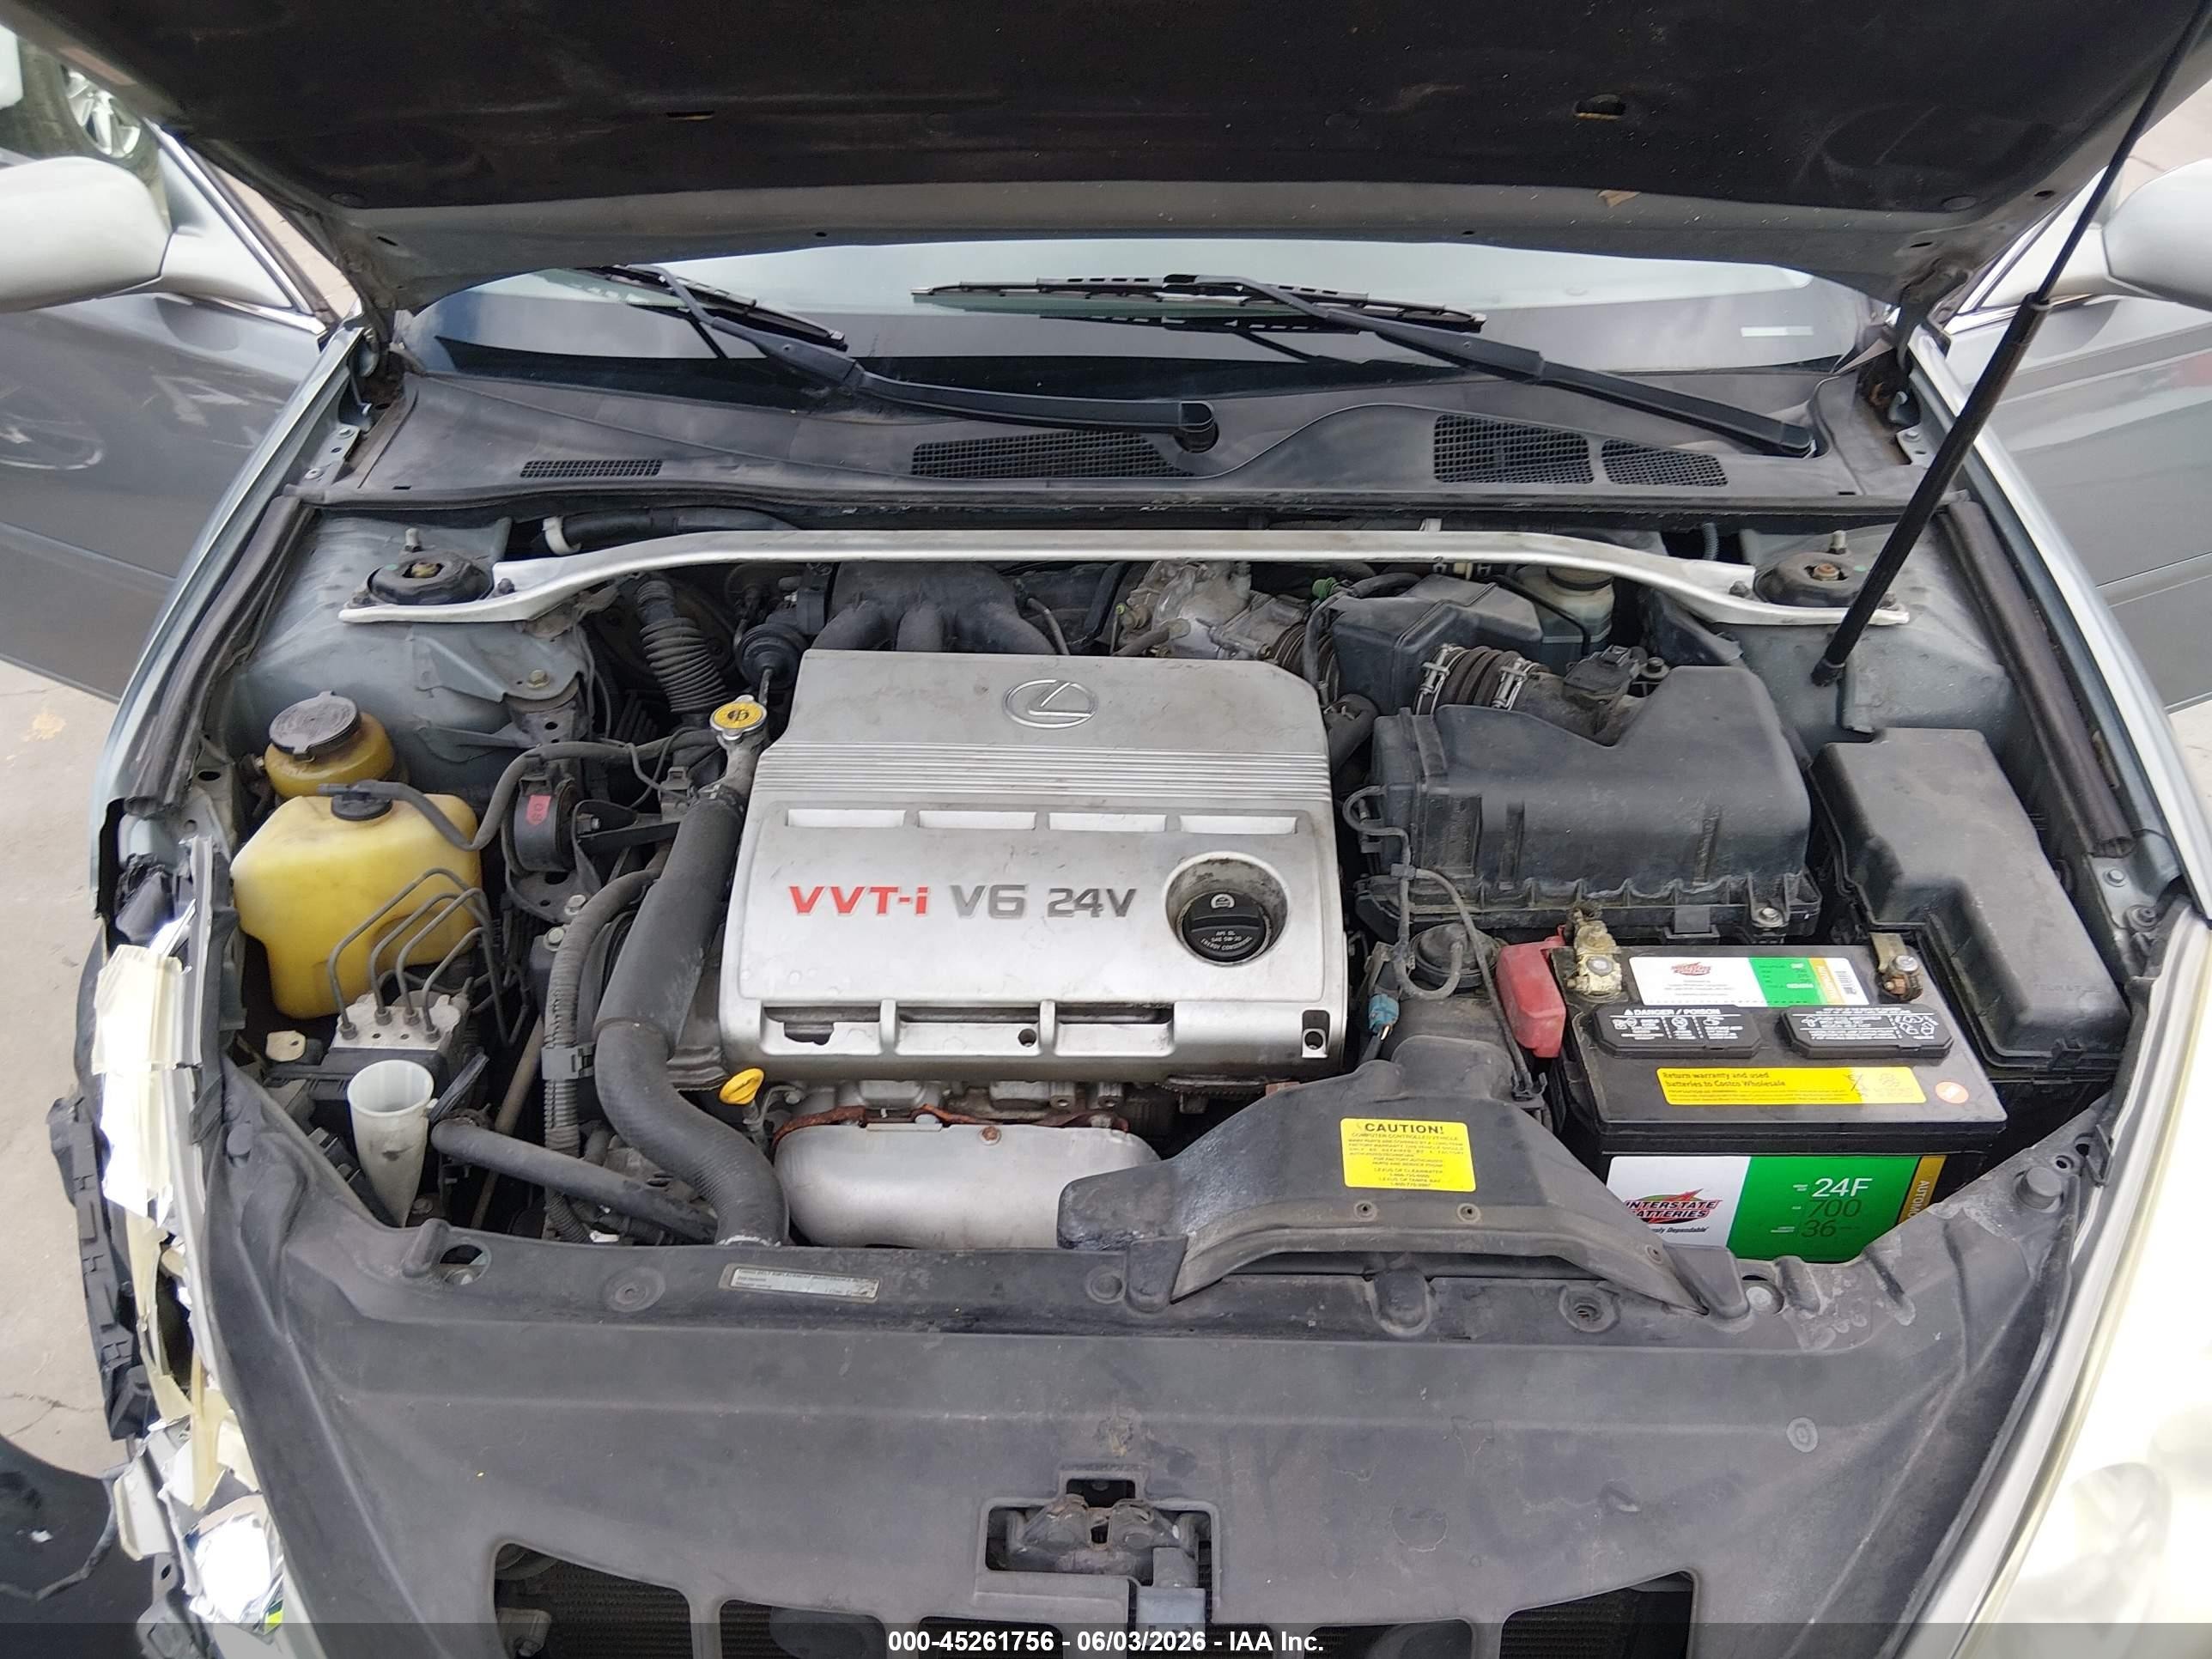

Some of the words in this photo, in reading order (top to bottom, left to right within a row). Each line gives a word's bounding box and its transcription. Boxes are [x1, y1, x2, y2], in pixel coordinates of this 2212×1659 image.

[789, 885, 929, 915] VVT-i
[950, 884, 1028, 919] V6
[1047, 888, 1137, 918] 24V
[1364, 1122, 1444, 1134] CAUTION!
[1811, 1177, 1873, 1197] 24F
[1808, 1199, 1862, 1218] 700
[1802, 1219, 1837, 1237] 36
